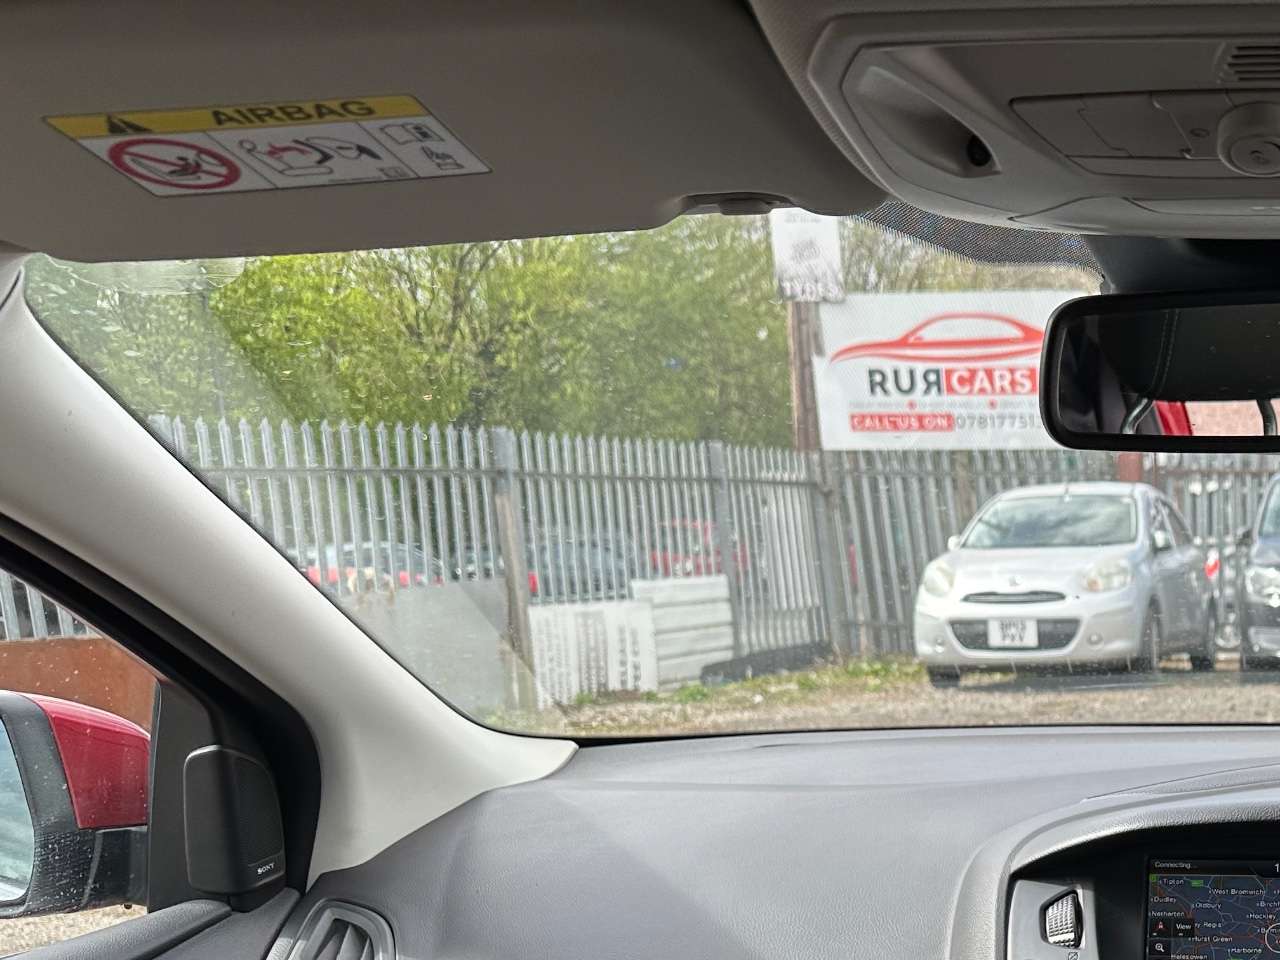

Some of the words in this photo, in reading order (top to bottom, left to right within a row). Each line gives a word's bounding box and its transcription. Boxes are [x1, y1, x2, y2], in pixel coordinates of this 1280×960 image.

[211, 100, 376, 126] AIRBAG
[951, 369, 1032, 395] CARS
[257, 862, 275, 875] SONY
[1163, 878, 1185, 886] Tipton
[1153, 896, 1177, 904] Dudley
[1195, 902, 1221, 910] Oldbury
